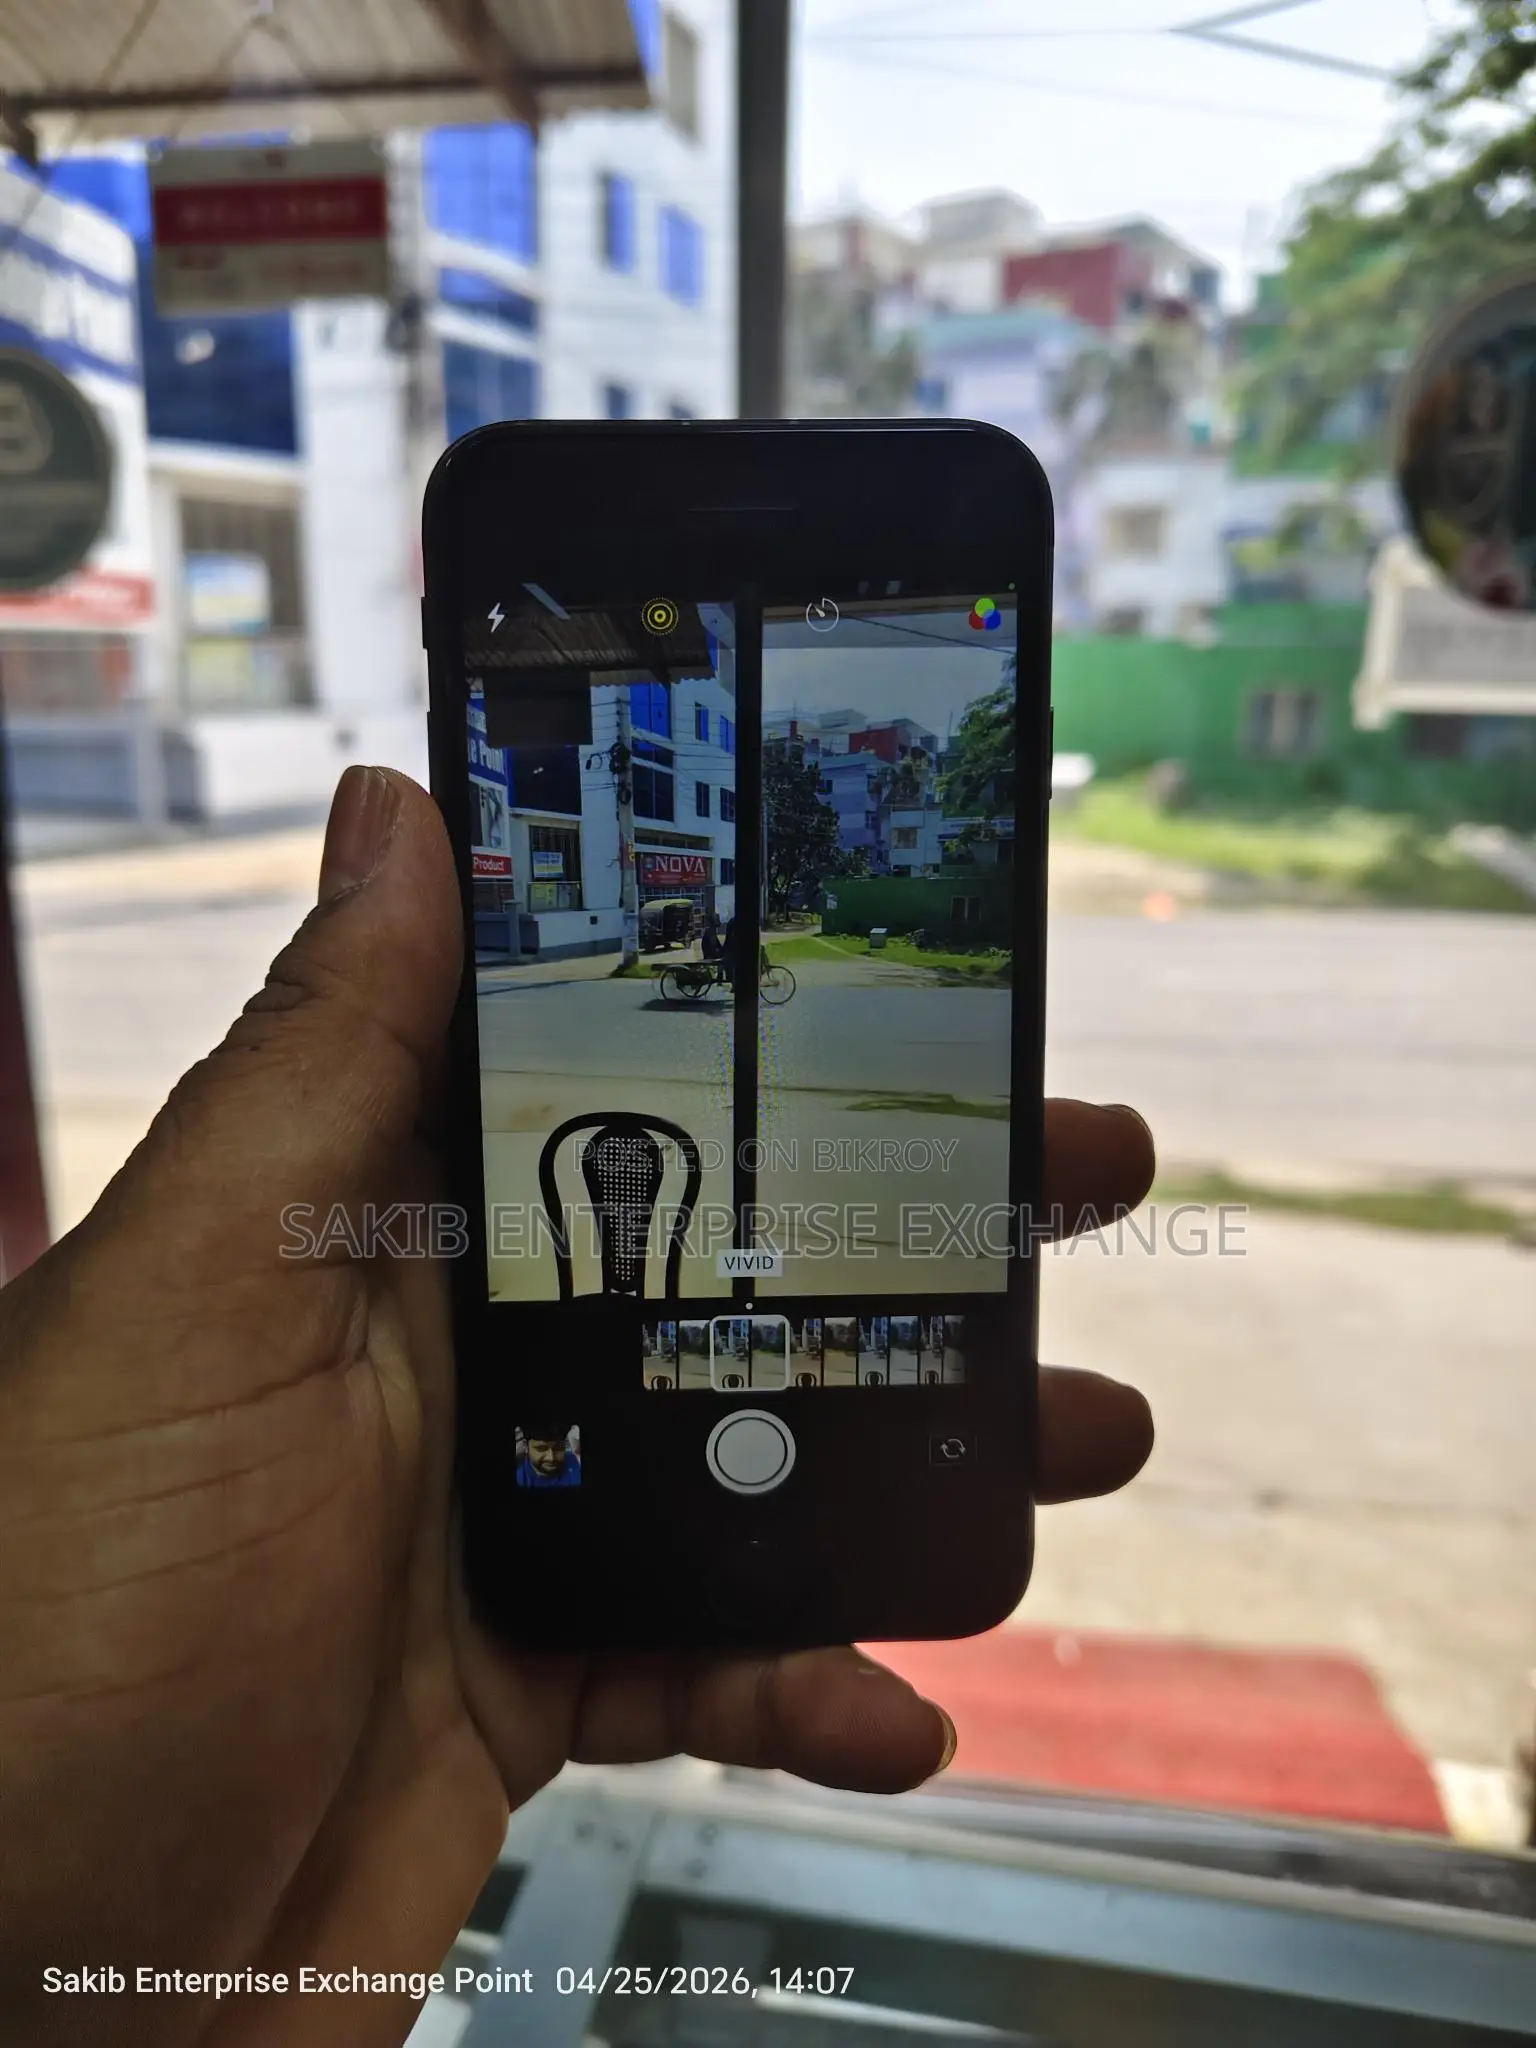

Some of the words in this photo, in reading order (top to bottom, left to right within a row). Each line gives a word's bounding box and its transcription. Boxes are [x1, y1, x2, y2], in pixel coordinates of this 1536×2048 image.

[472, 855, 505, 872] Product
[655, 855, 705, 872] NOVA
[724, 1255, 774, 1271] VIVID
